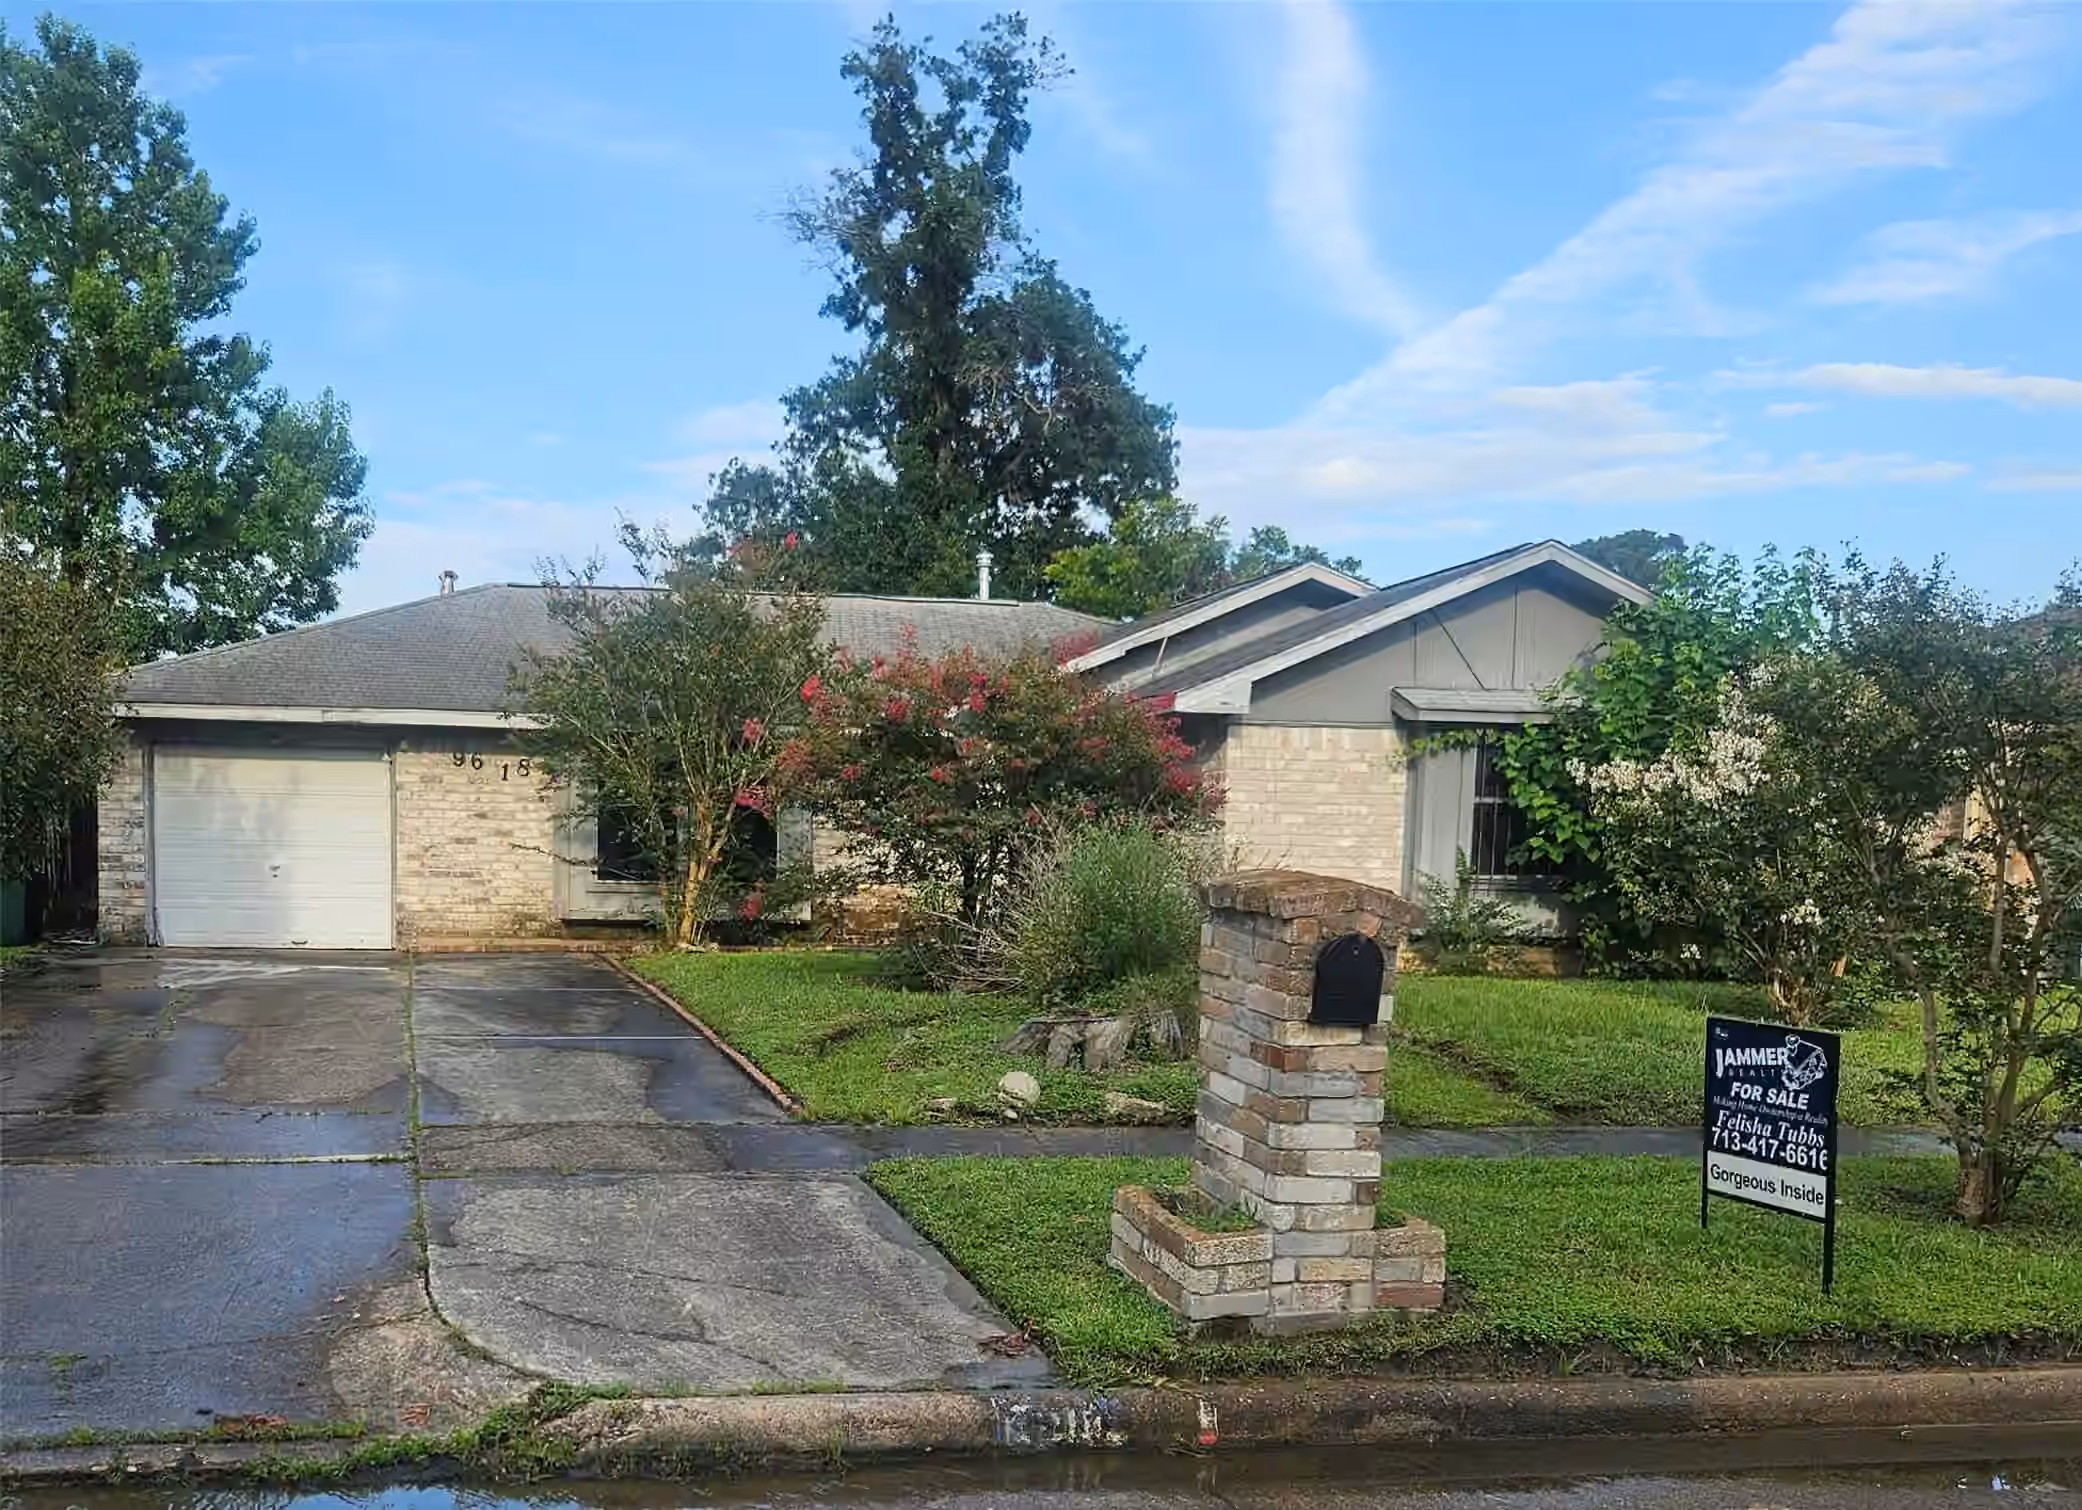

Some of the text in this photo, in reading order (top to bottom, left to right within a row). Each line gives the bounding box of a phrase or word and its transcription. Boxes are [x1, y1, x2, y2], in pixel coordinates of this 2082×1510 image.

[1715, 1047, 1789, 1079] JAMMER
[1730, 1081, 1810, 1110] FOR SALE
[1716, 1110, 1825, 1148] Felisha Tubbs
[1711, 1163, 1824, 1206] Gorgeous Inside
